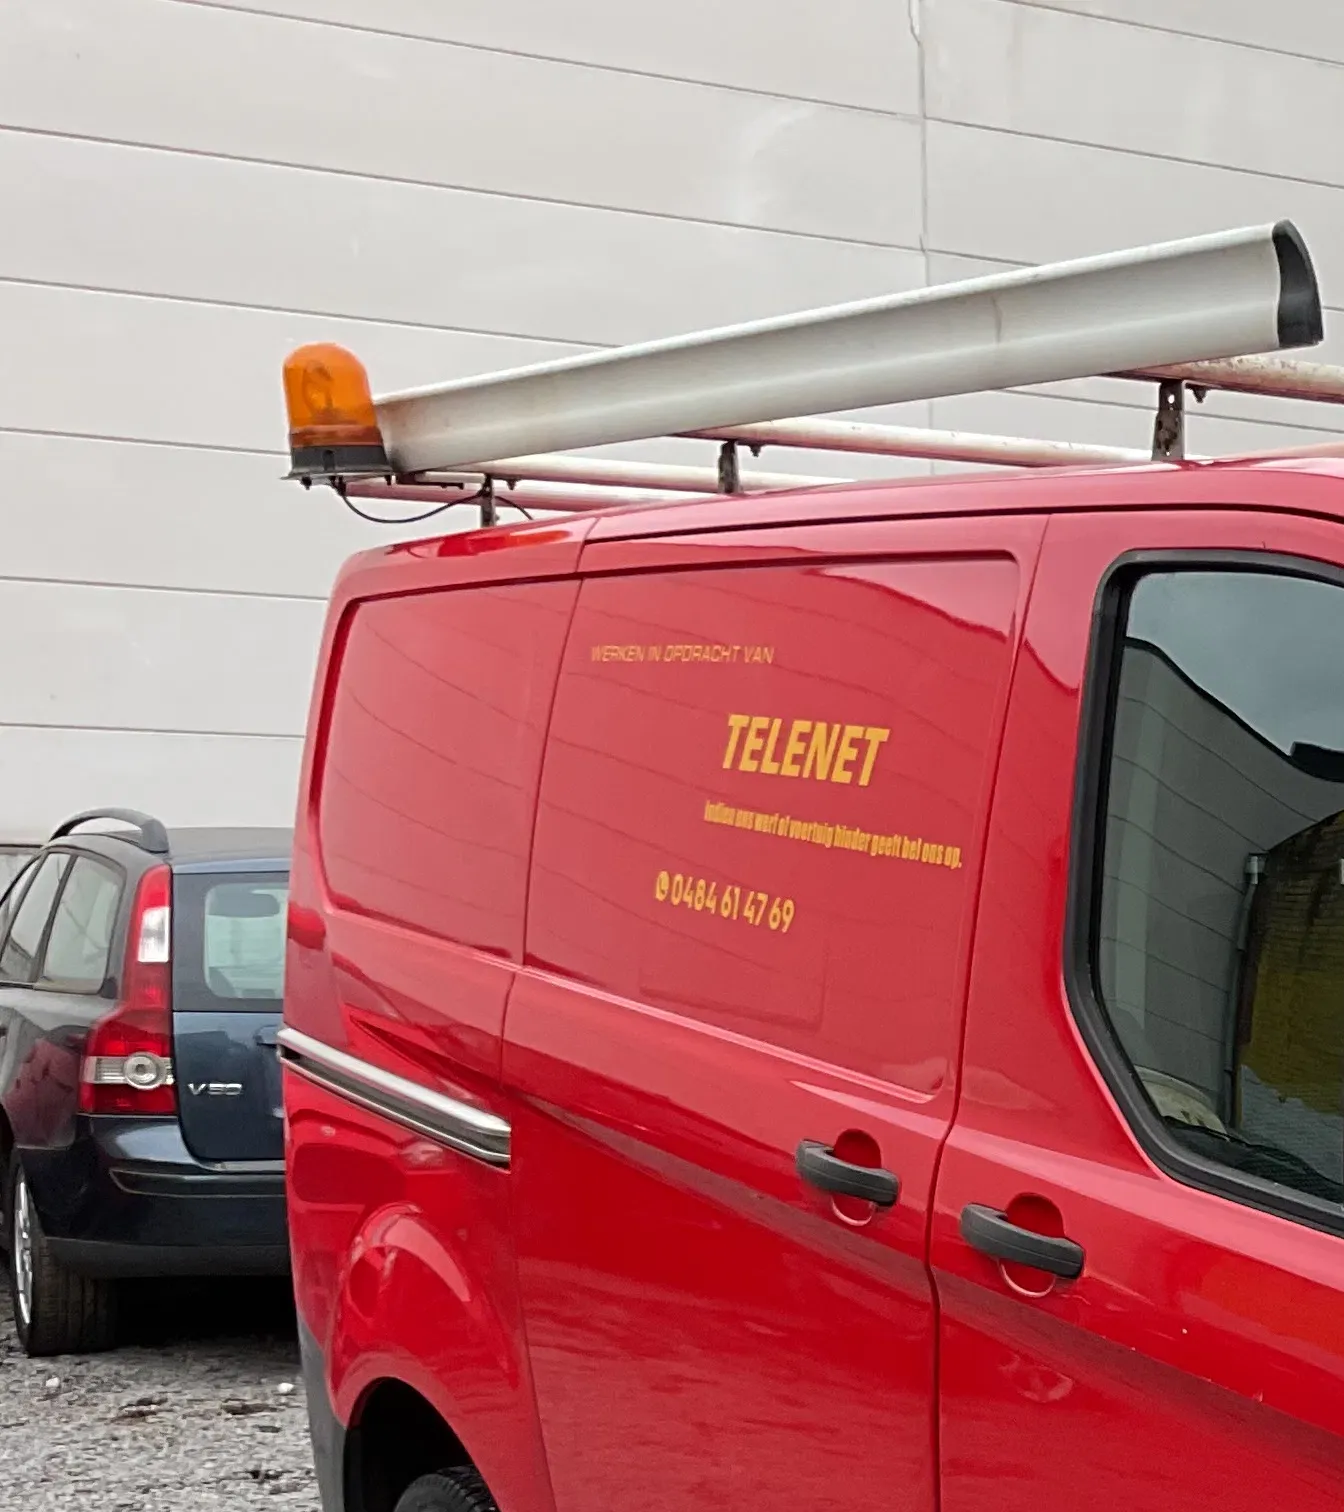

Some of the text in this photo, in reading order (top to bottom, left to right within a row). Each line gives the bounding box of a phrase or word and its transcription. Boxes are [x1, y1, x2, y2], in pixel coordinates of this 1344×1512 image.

[591, 645, 775, 664] WERKEN IN OPDRACHT VAN
[722, 713, 890, 787] TELENET
[754, 812, 779, 834] werf
[789, 820, 833, 848] voertuig
[833, 824, 871, 853] hinder
[870, 834, 901, 857] geeft
[901, 836, 922, 861] bel
[921, 842, 944, 865] ons
[670, 874, 795, 934] 0484 61 47 69
[188, 1083, 243, 1096] V50
